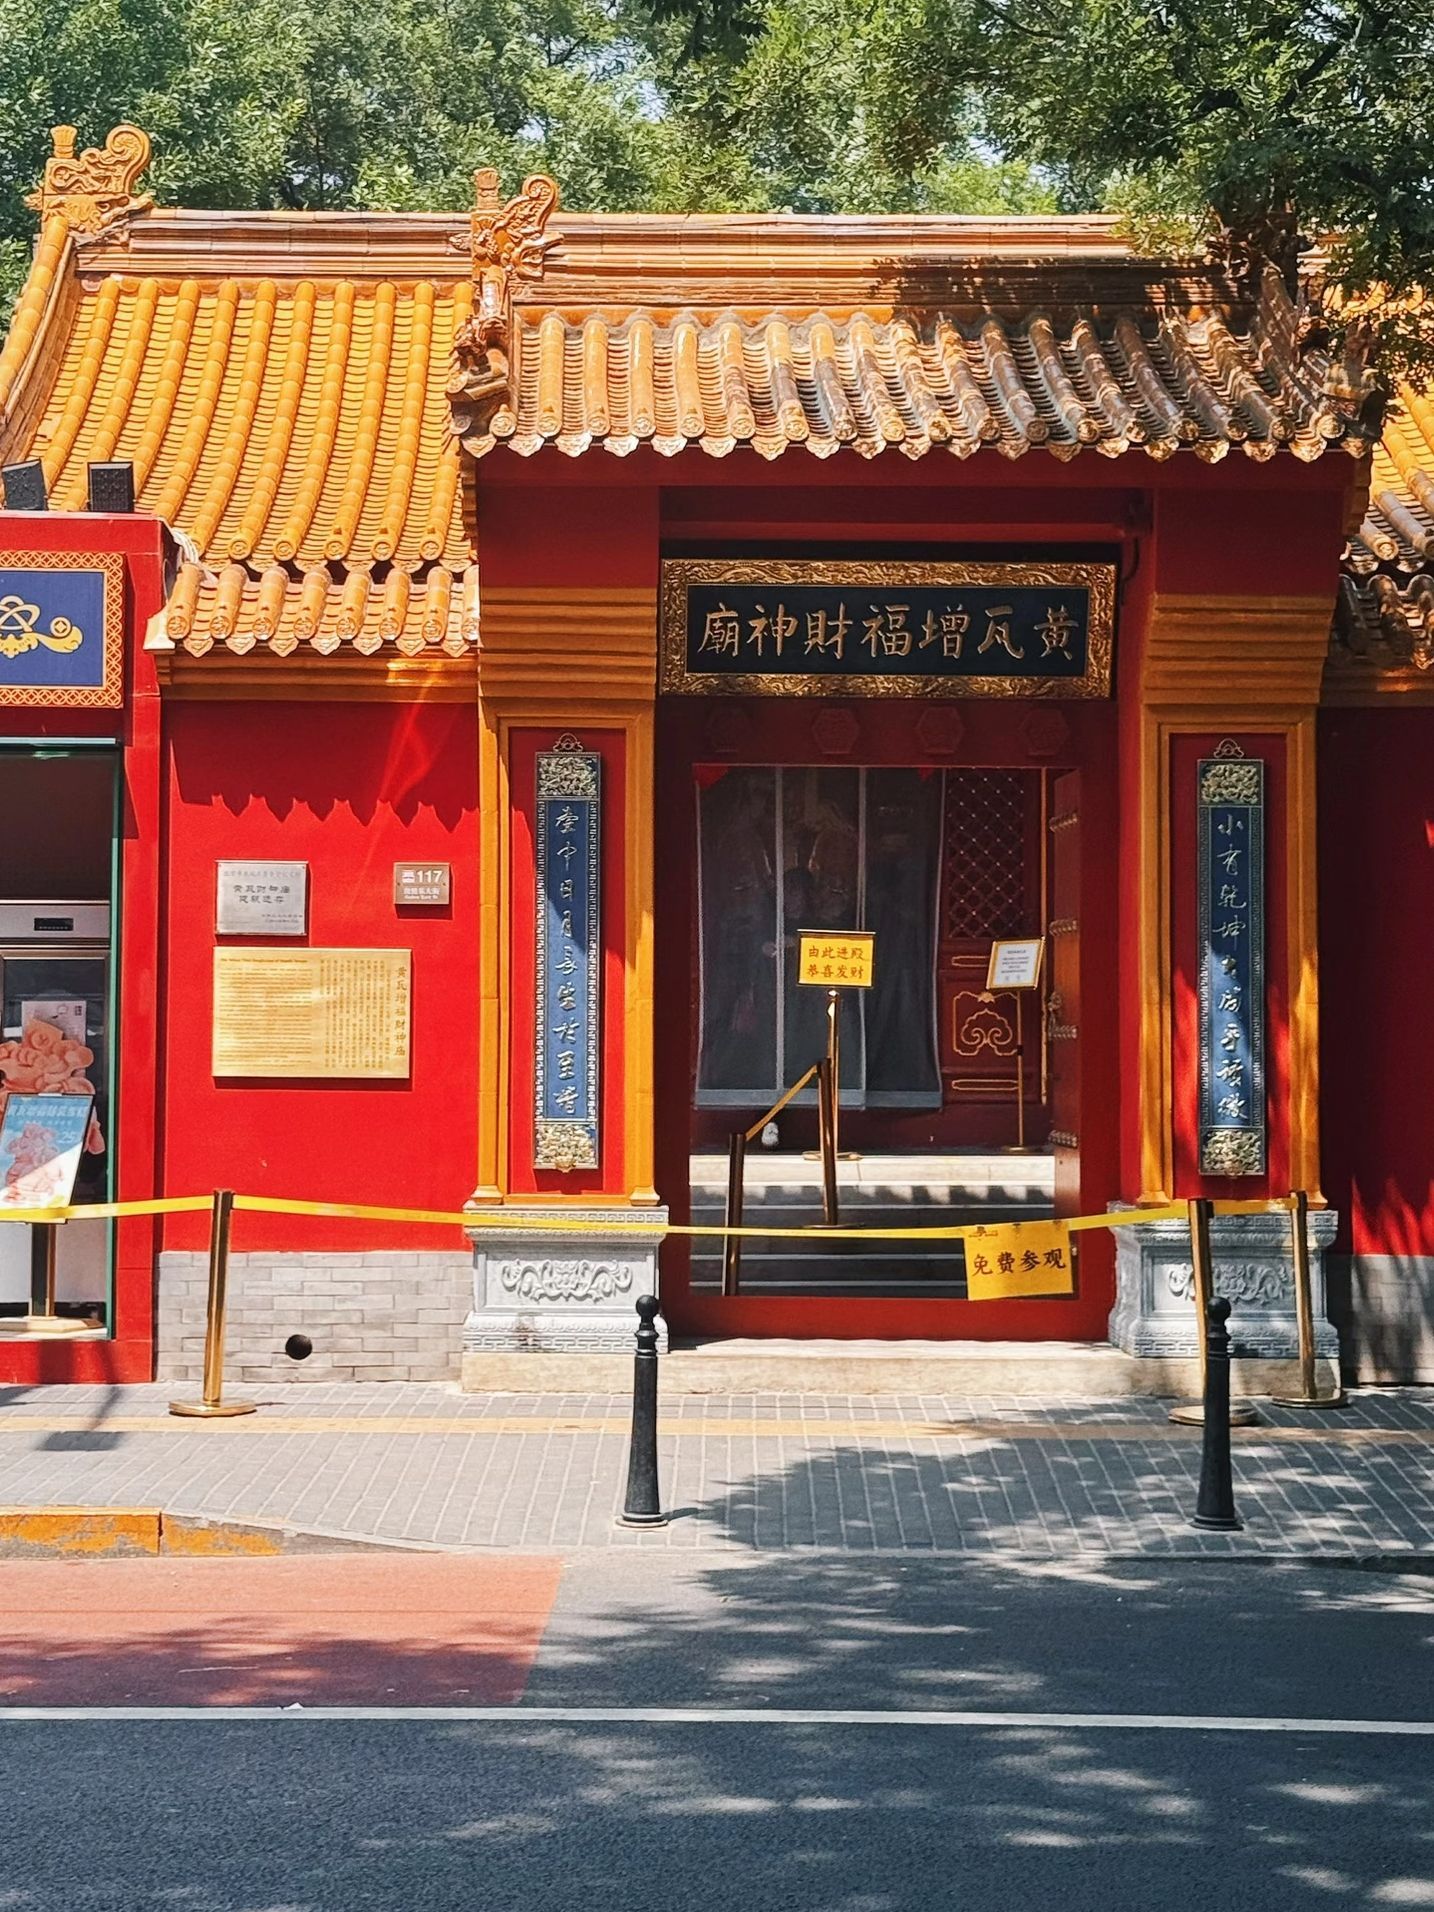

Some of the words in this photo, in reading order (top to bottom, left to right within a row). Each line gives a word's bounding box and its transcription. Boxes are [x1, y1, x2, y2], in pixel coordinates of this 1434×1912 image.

[416, 870, 443, 883] 117
[808, 945, 867, 961] 由此进殿
[807, 963, 865, 979] 恭喜发财
[971, 1247, 1067, 1277] 免费参观
